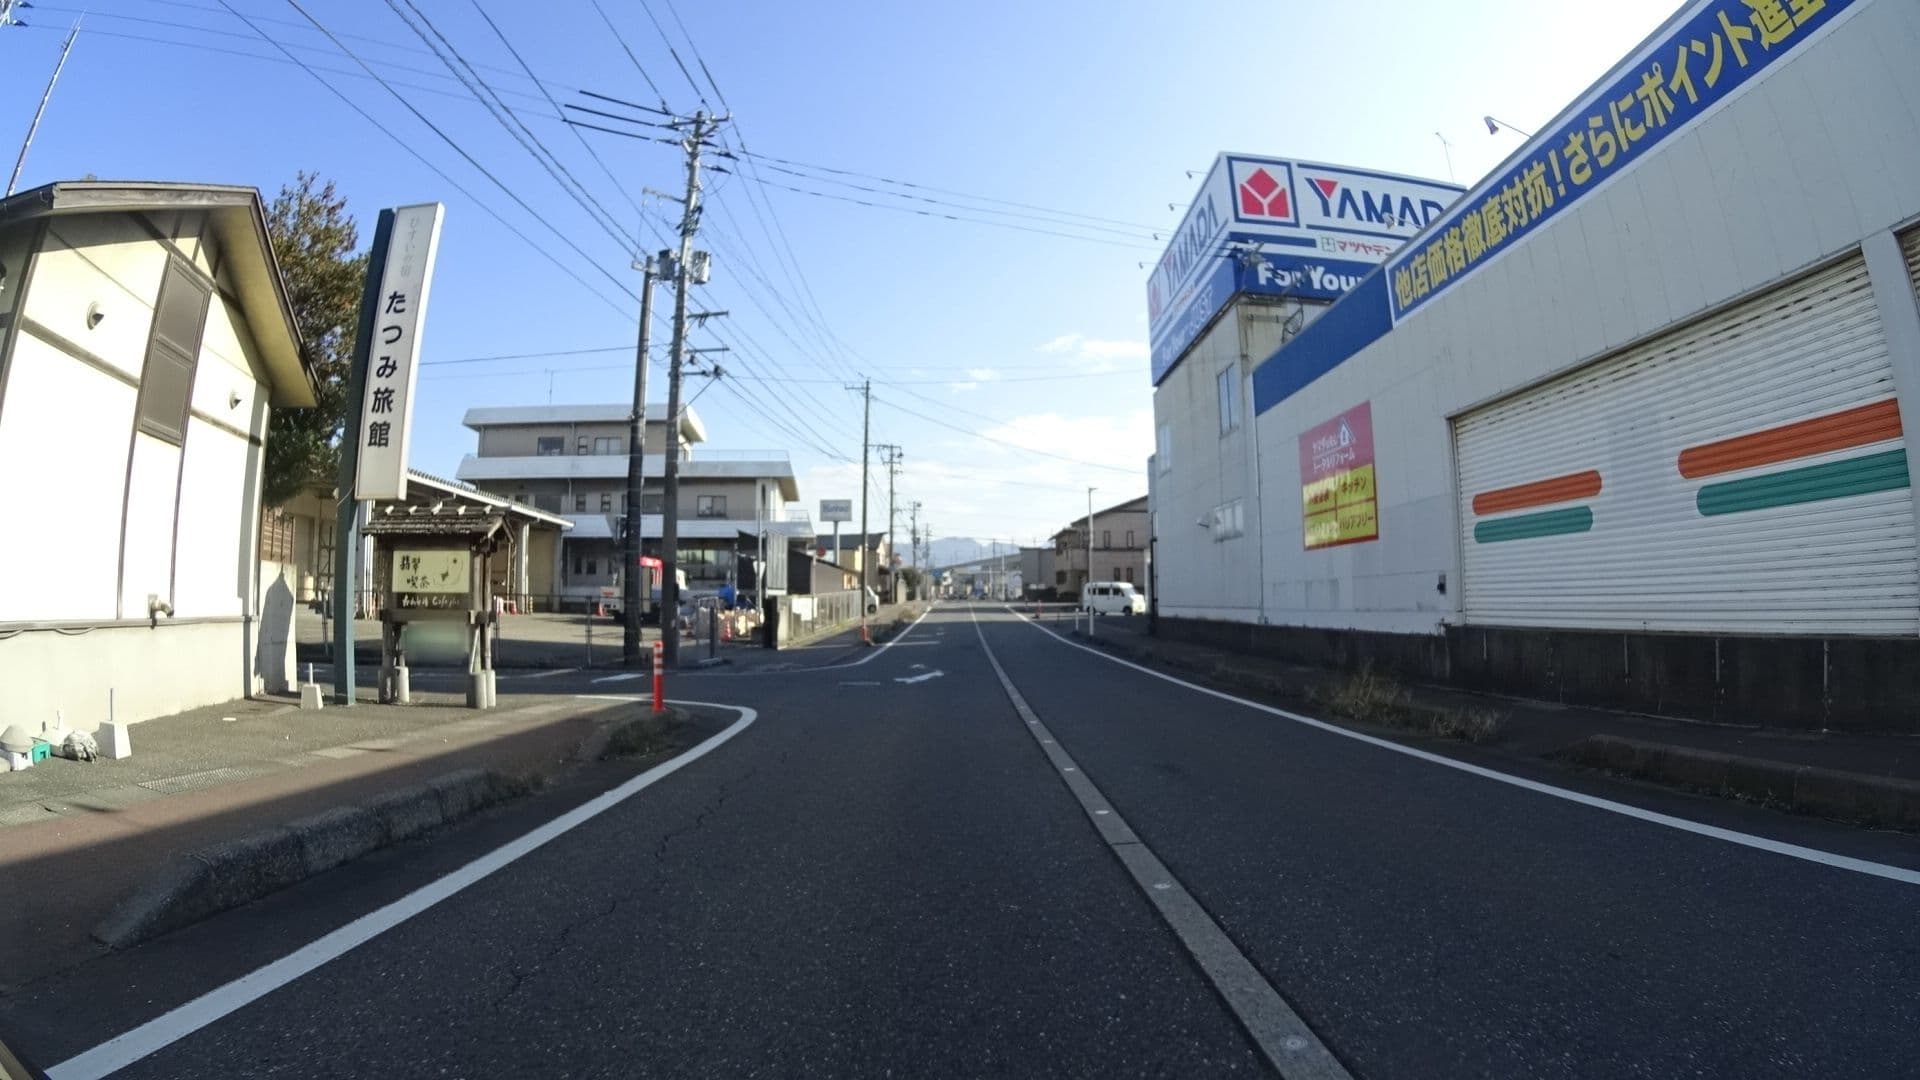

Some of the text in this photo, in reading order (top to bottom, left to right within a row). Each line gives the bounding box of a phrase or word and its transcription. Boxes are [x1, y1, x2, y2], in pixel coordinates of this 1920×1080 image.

[1163, 193, 1219, 297] YAMADA
[367, 291, 406, 448] たつみ旅館
